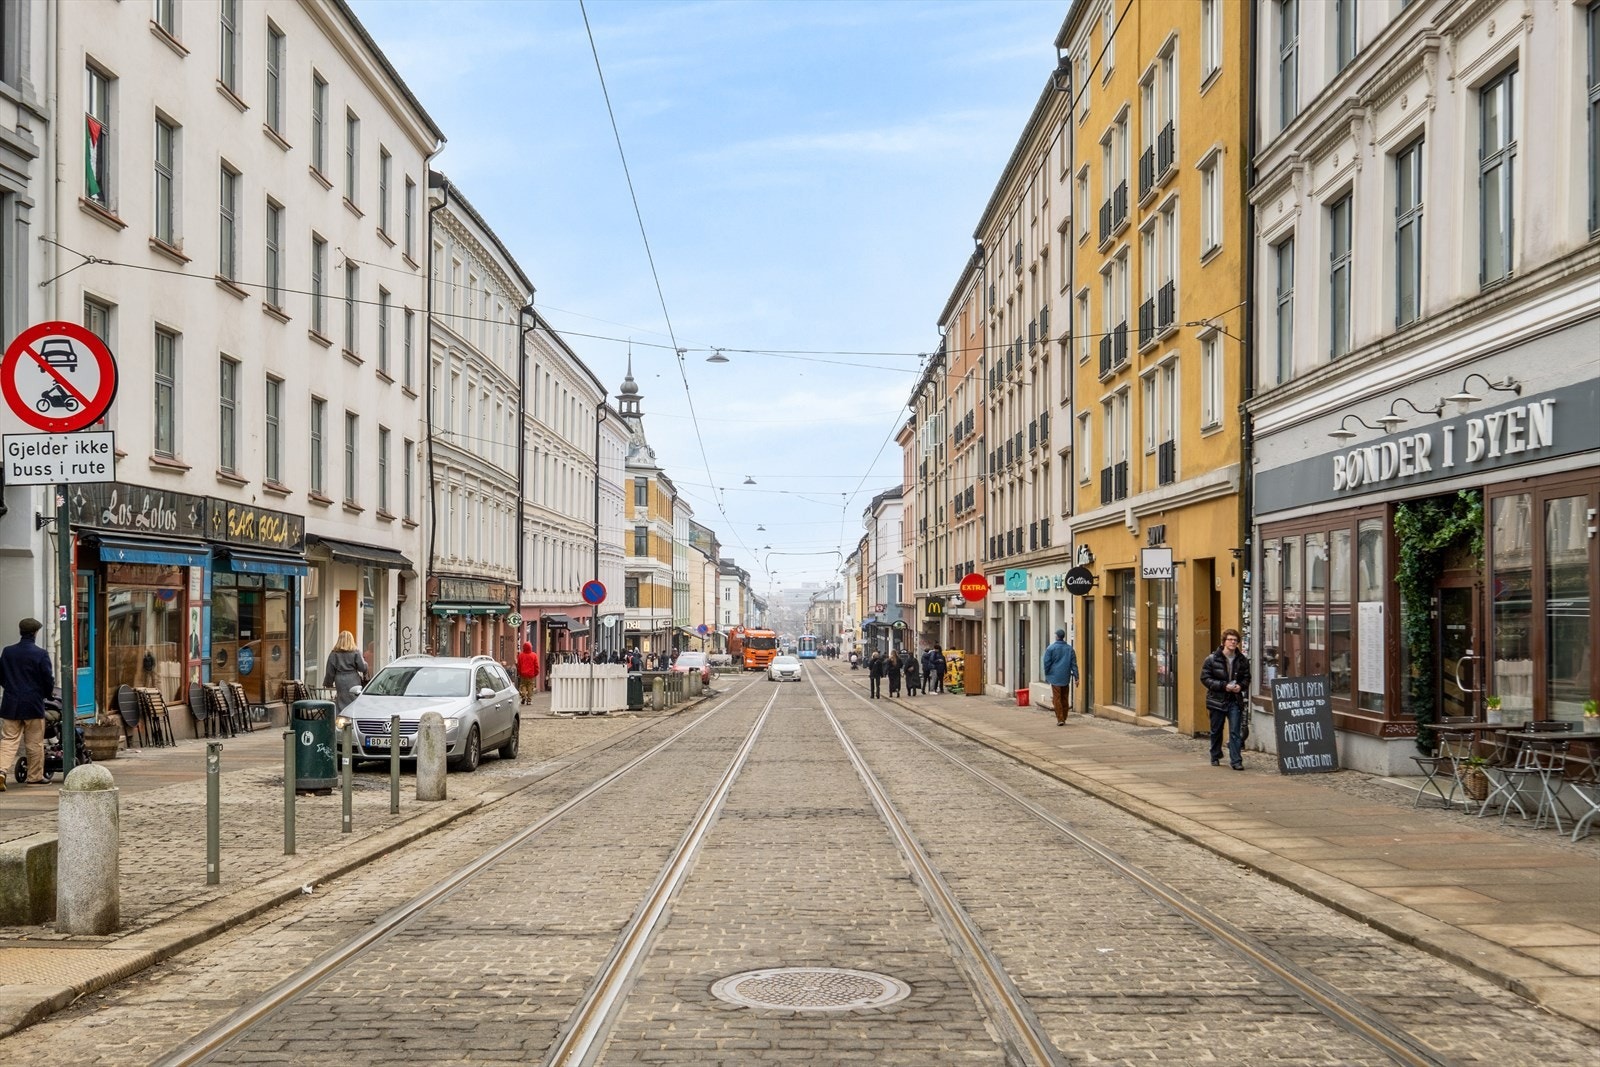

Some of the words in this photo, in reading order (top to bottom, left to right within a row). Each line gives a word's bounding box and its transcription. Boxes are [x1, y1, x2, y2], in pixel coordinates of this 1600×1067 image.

[8, 441, 68, 460] Gjelder
[75, 439, 109, 454] ikke
[1333, 432, 1432, 491] BØNDER
[1442, 425, 1455, 468] I
[1465, 398, 1556, 463] BYEN
[13, 462, 52, 477] buss
[60, 461, 64, 475] i
[72, 461, 105, 475] rute
[102, 489, 132, 526] Los
[135, 494, 177, 531] Lobos
[227, 508, 254, 540] BAR
[259, 514, 288, 543] BOCA
[1306, 681, 1324, 697] BYEN
[371, 738, 381, 746] BD
[1284, 721, 1305, 742] ÅPENT
[1306, 721, 1322, 740] FRA
